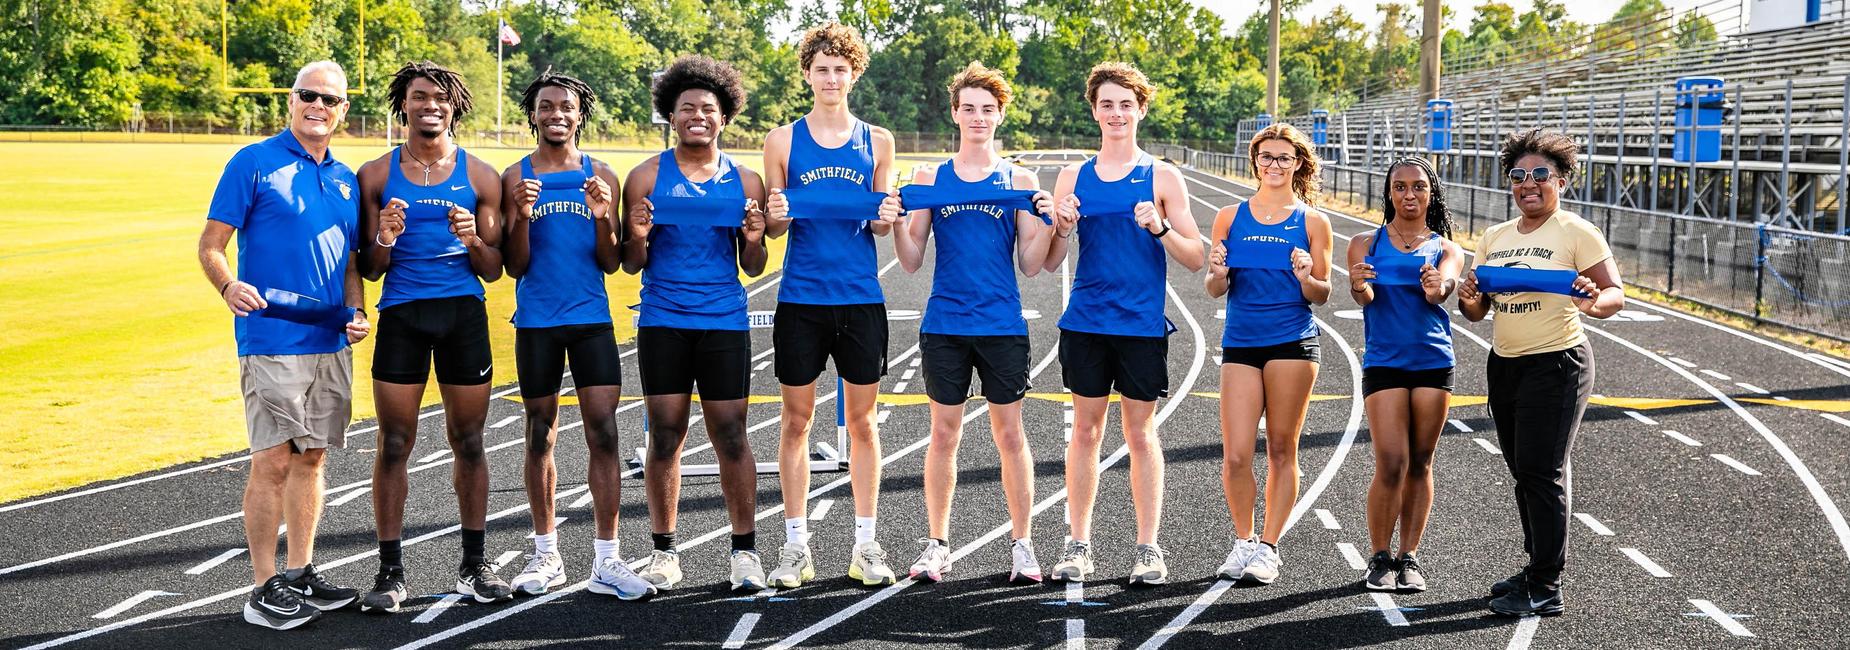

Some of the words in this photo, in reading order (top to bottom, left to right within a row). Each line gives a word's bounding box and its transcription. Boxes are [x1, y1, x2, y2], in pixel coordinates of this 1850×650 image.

[800, 167, 864, 185] SMITHFIELD
[1531, 247, 1554, 260] TRACK
[1510, 300, 1542, 314] EMPTY!
[748, 314, 775, 326] FIELD
